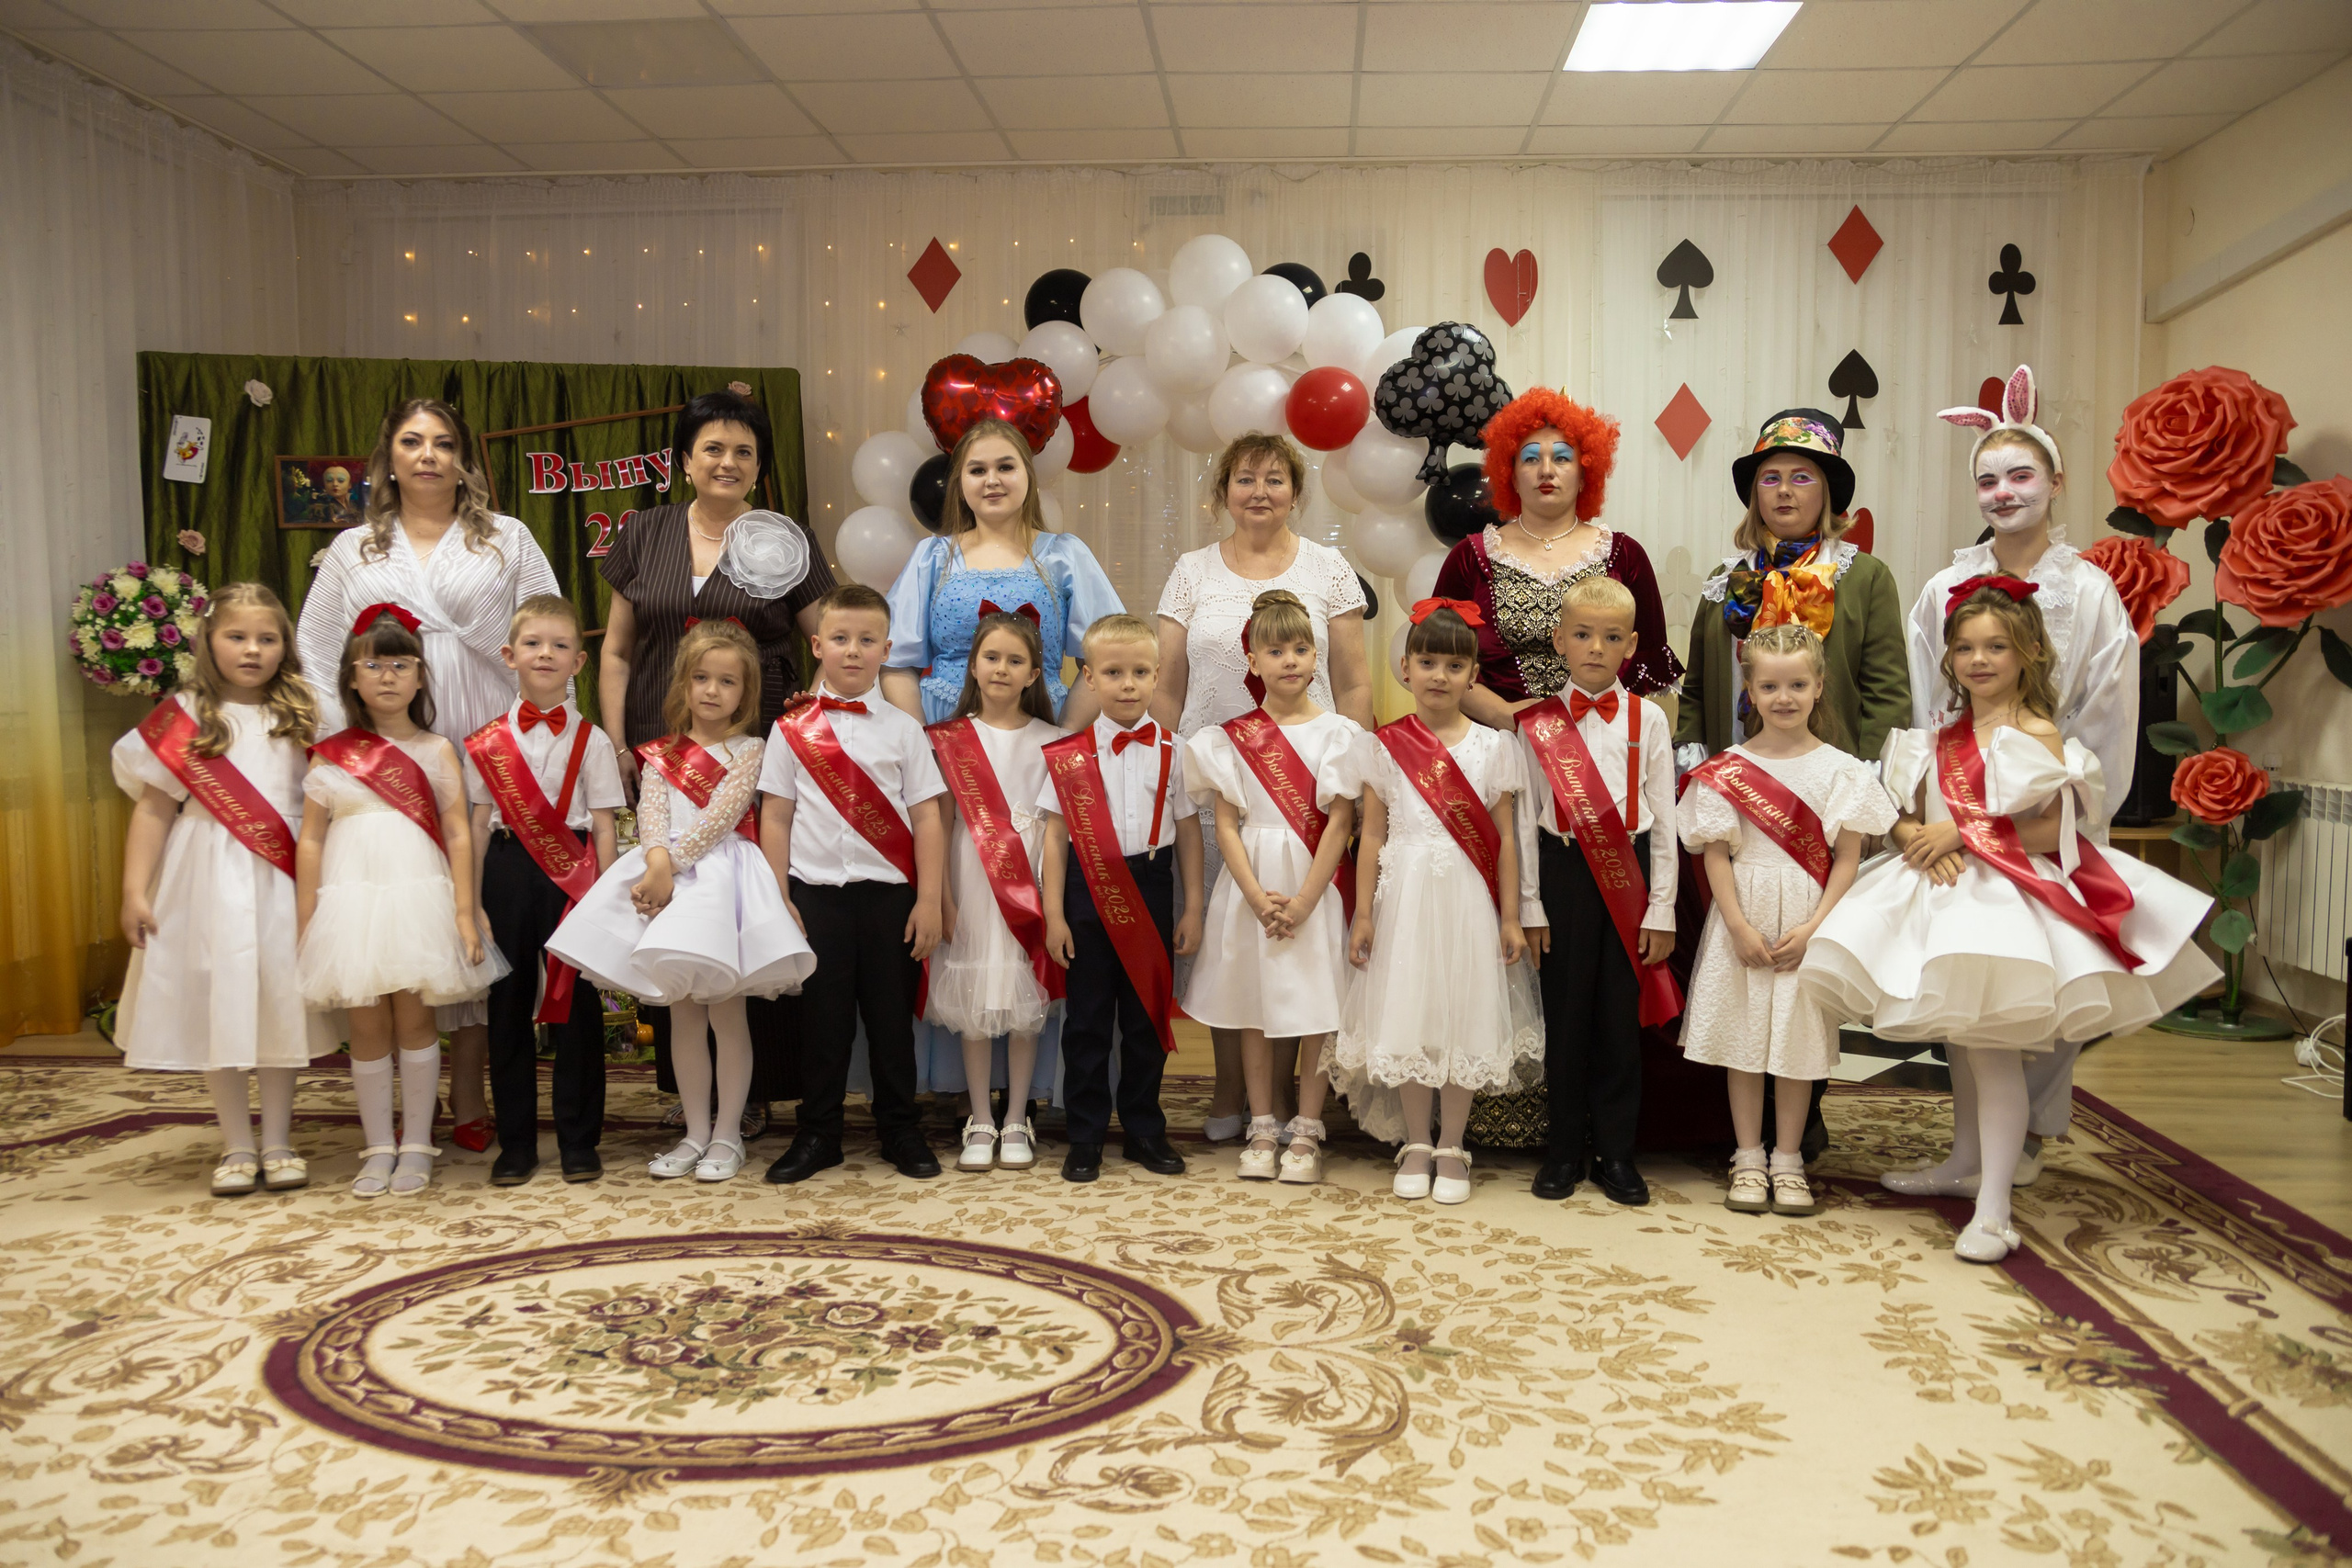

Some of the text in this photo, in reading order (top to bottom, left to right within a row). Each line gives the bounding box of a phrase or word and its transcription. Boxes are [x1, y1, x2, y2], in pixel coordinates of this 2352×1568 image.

[526, 447, 673, 493] Выпу
[175, 748, 288, 860] ыпускник 2025
[486, 741, 543, 833] Выпускник
[537, 834, 580, 871] 2025
[797, 721, 859, 804] Выпускник
[855, 801, 892, 836] 2025
[954, 744, 1018, 880] Выпускник 2025
[1256, 739, 1320, 831] Выпускник
[1555, 744, 1631, 888] Выпускник 2025
[1711, 760, 1829, 869] Выпускник 2025
[1944, 739, 1984, 817] Выпускник
[1973, 818, 2004, 854] 2025
[1070, 779, 1136, 923] Выпускник 2025
